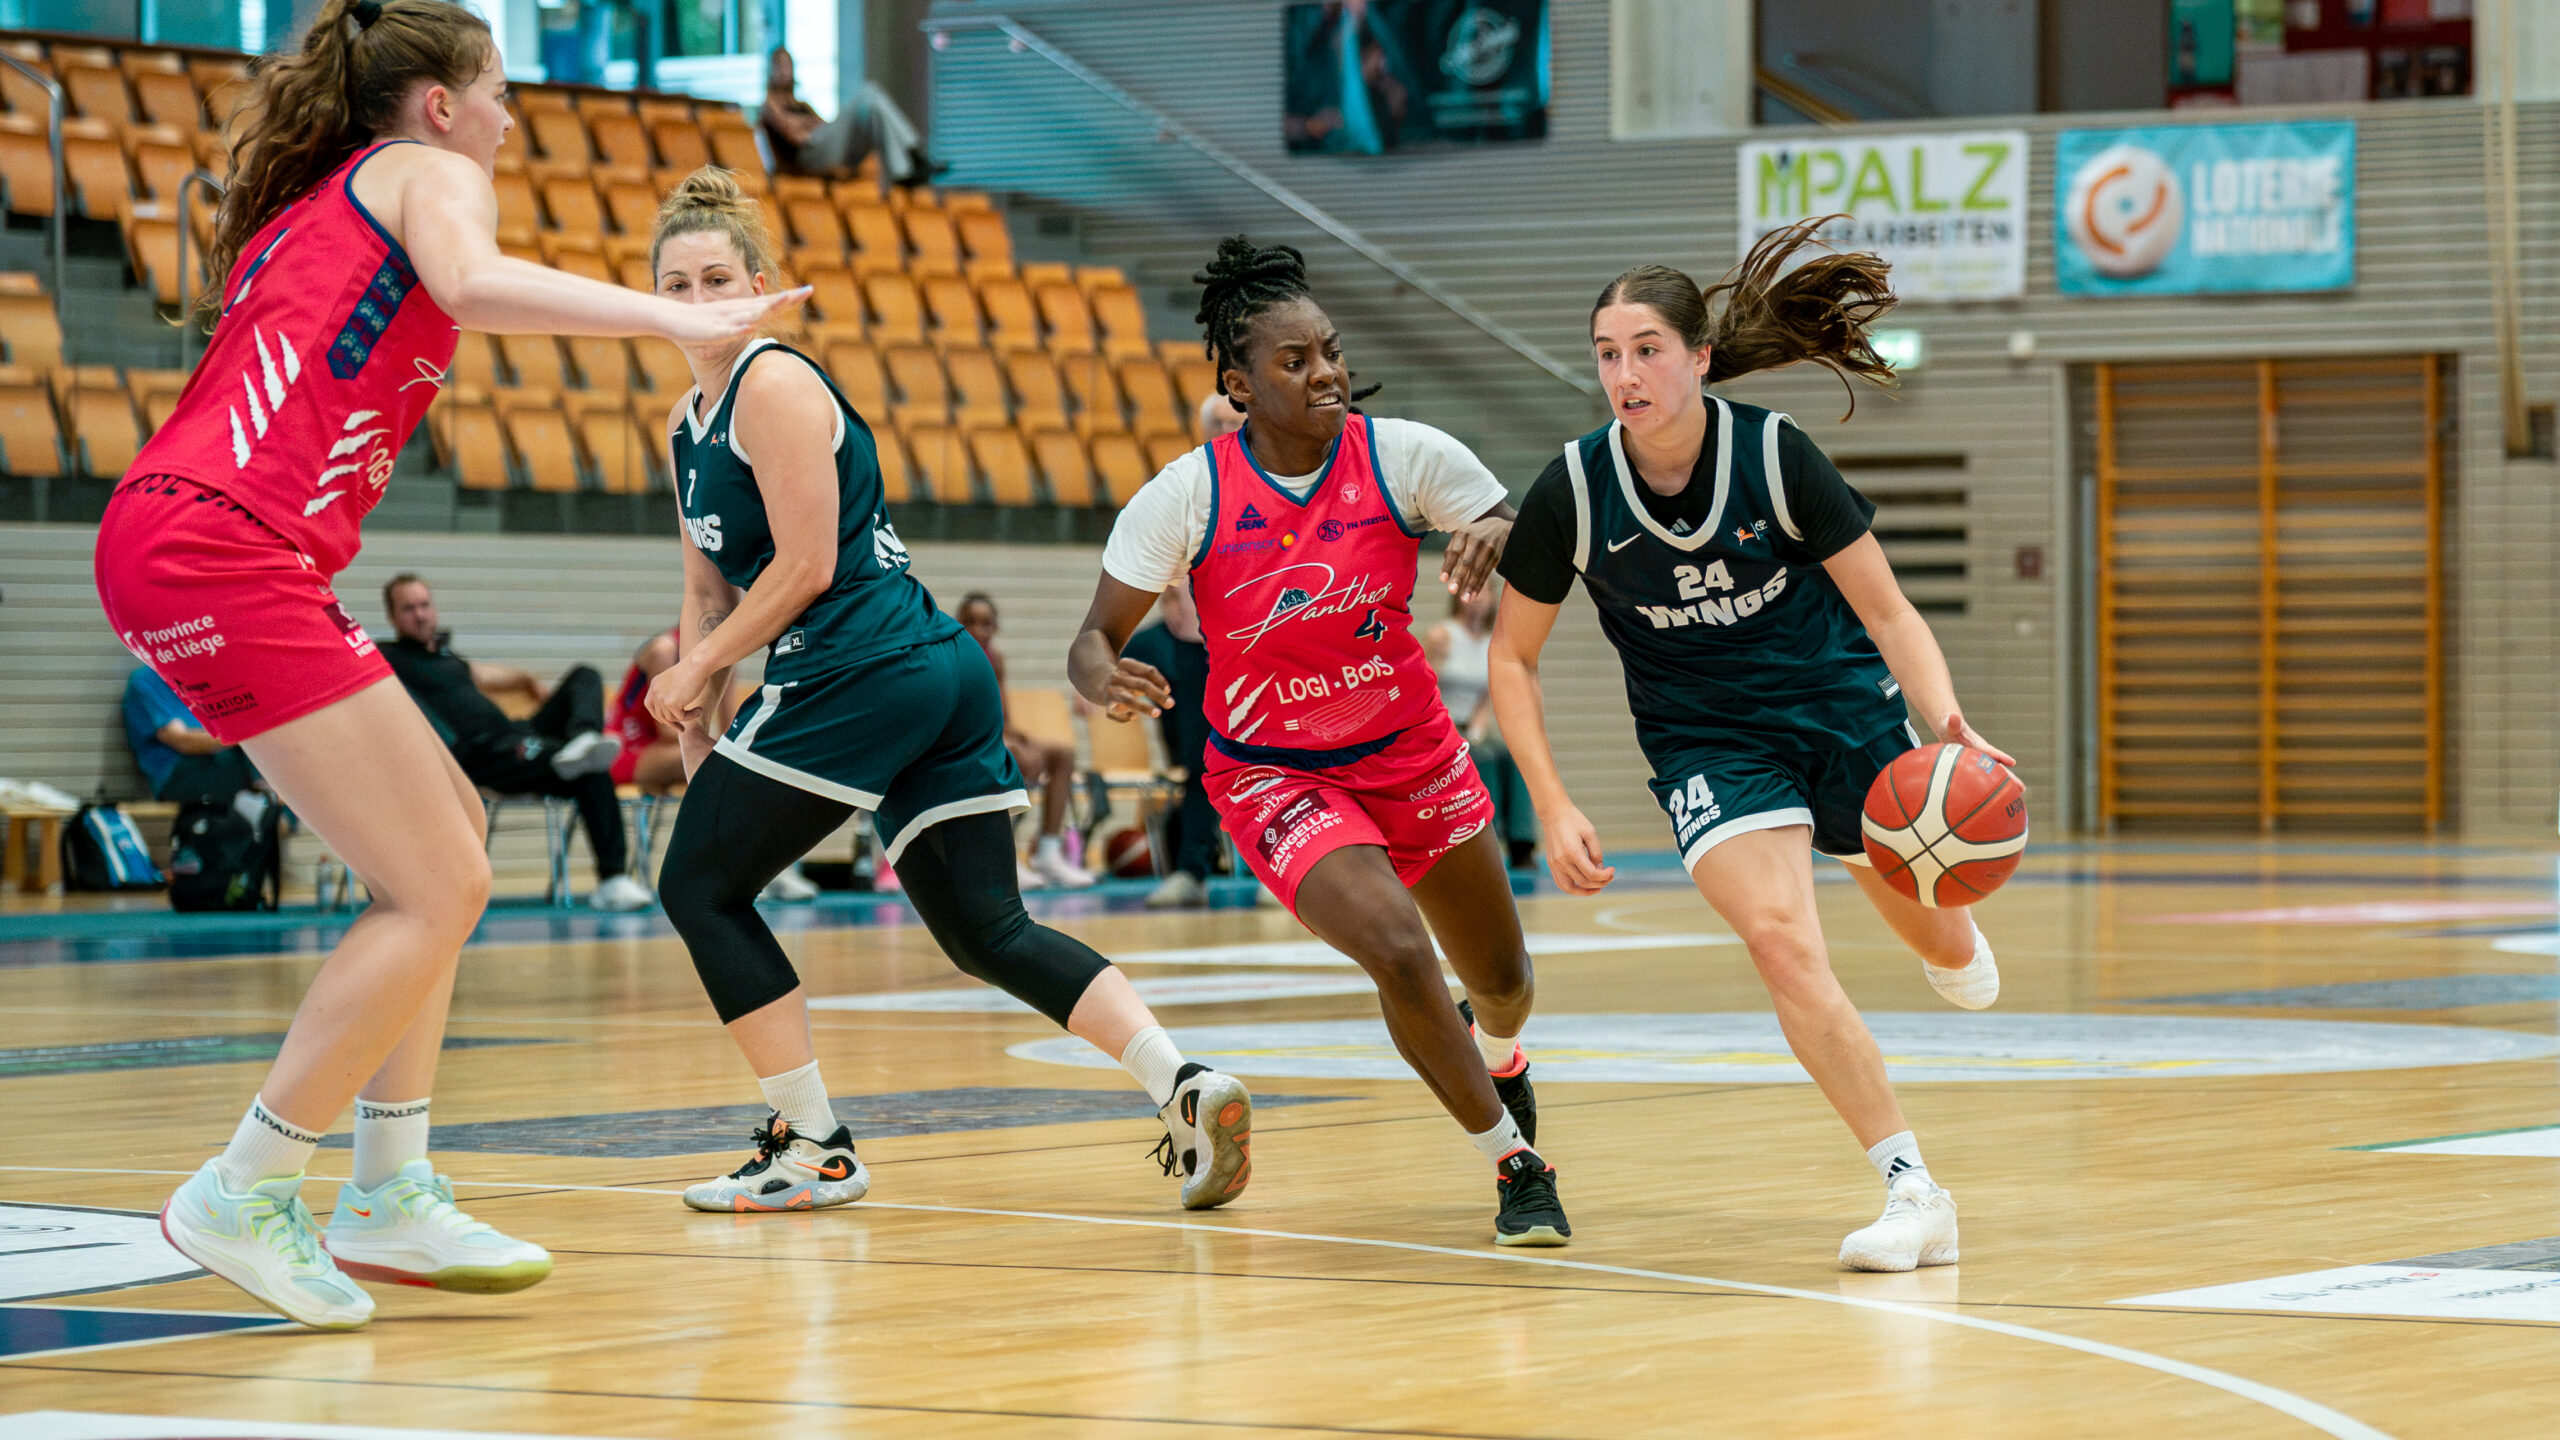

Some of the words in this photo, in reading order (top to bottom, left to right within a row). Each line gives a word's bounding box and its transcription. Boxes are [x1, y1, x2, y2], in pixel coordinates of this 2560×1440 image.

[2192, 157, 2342, 213] LOTERIE
[686, 469, 696, 508] 7
[1236, 518, 1267, 531] PEAK
[1360, 514, 1390, 527] HERSTAL
[1217, 537, 1276, 554] unisensor
[1635, 567, 1788, 629] WINGS
[1673, 559, 1735, 600] 24
[142, 615, 216, 646] Province
[792, 636, 803, 647] XL
[1354, 609, 1388, 642] 4
[156, 648, 177, 664] de
[172, 634, 226, 657] Liège
[1275, 674, 1330, 704] LOGI
[1341, 655, 1394, 689] BOIS
[1668, 773, 1714, 833] 24
[1269, 811, 1331, 872] LANGELLA
[1277, 852, 1294, 878] HERVE
[1295, 834, 1312, 849] 087
[1312, 827, 1323, 835] 67
[1322, 821, 1334, 829] 88
[1333, 817, 1343, 827] 97
[253, 1105, 320, 1144] SPALDIN
